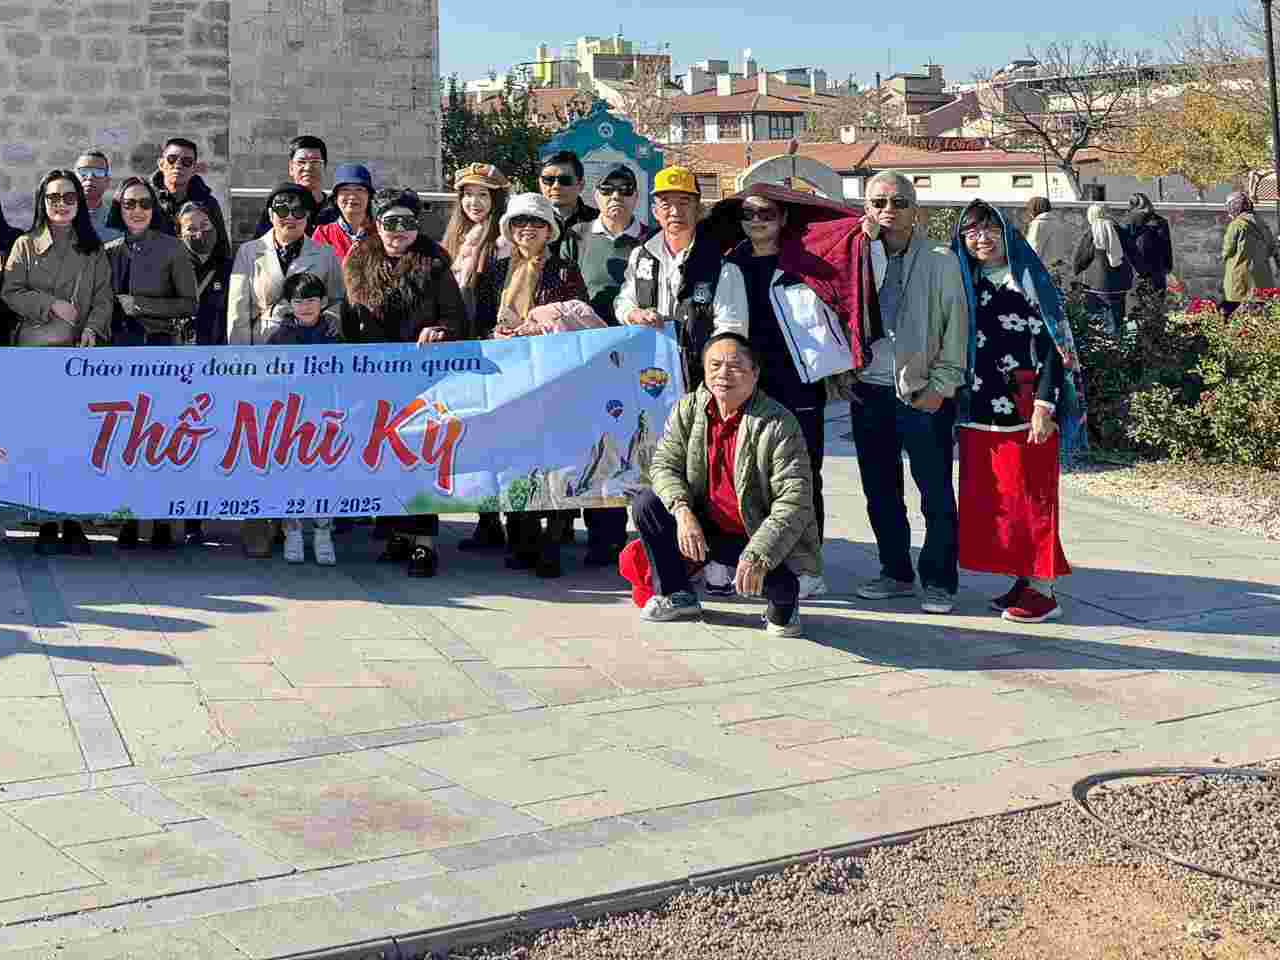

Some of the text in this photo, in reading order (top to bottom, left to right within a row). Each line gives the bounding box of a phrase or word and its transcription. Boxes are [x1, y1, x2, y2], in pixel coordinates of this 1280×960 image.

[266, 356, 295, 375] du
[352, 354, 414, 375] tham
[421, 356, 481, 377] quan
[86, 391, 217, 476] Thổ
[219, 391, 352, 476] Nhĩ
